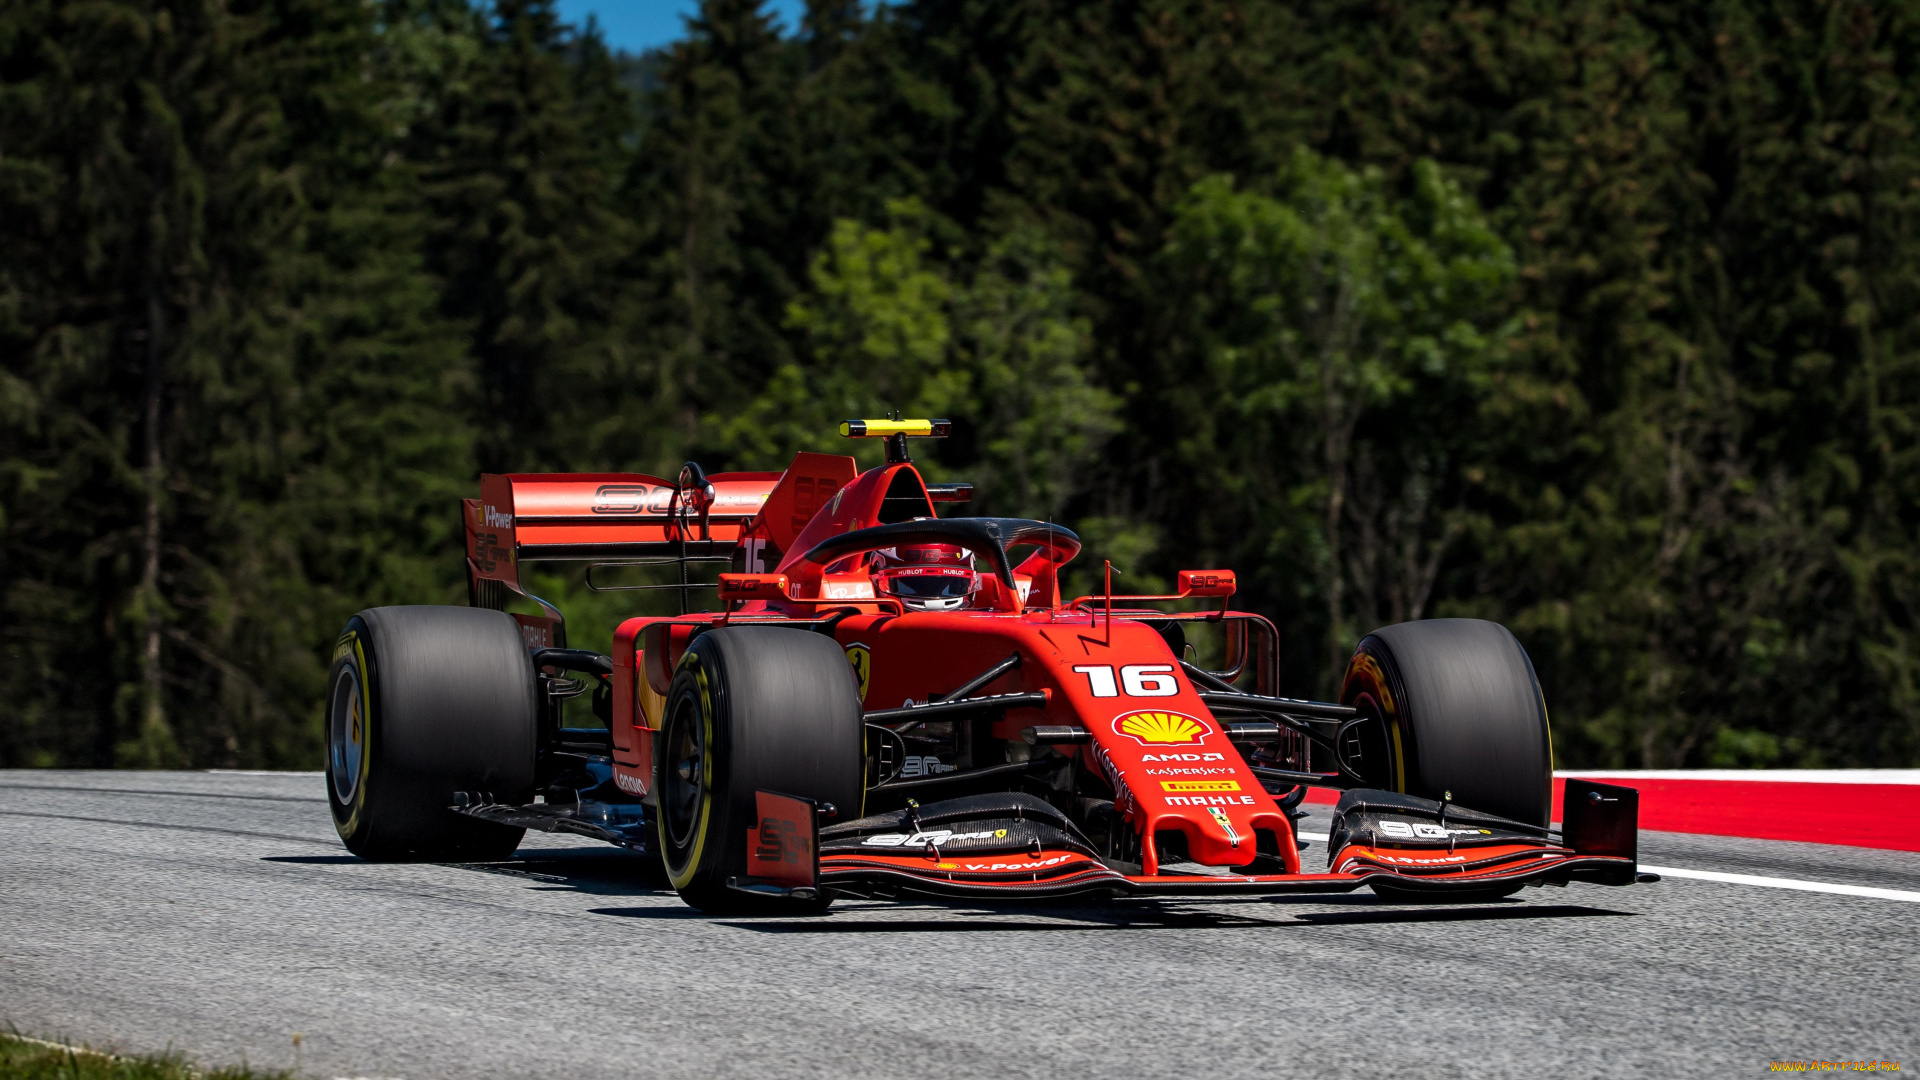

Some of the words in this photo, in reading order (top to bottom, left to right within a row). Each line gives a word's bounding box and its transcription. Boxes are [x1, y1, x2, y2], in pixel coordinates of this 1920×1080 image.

[484, 505, 512, 529] V-Power
[523, 625, 547, 648] MAHLE
[1072, 664, 1180, 697] 16
[1142, 754, 1201, 762] AMD
[1146, 767, 1226, 775] KASPERSKY
[614, 767, 648, 795] Lenovo
[1164, 796, 1256, 805] MAHLE
[965, 855, 1072, 870] V-Power
